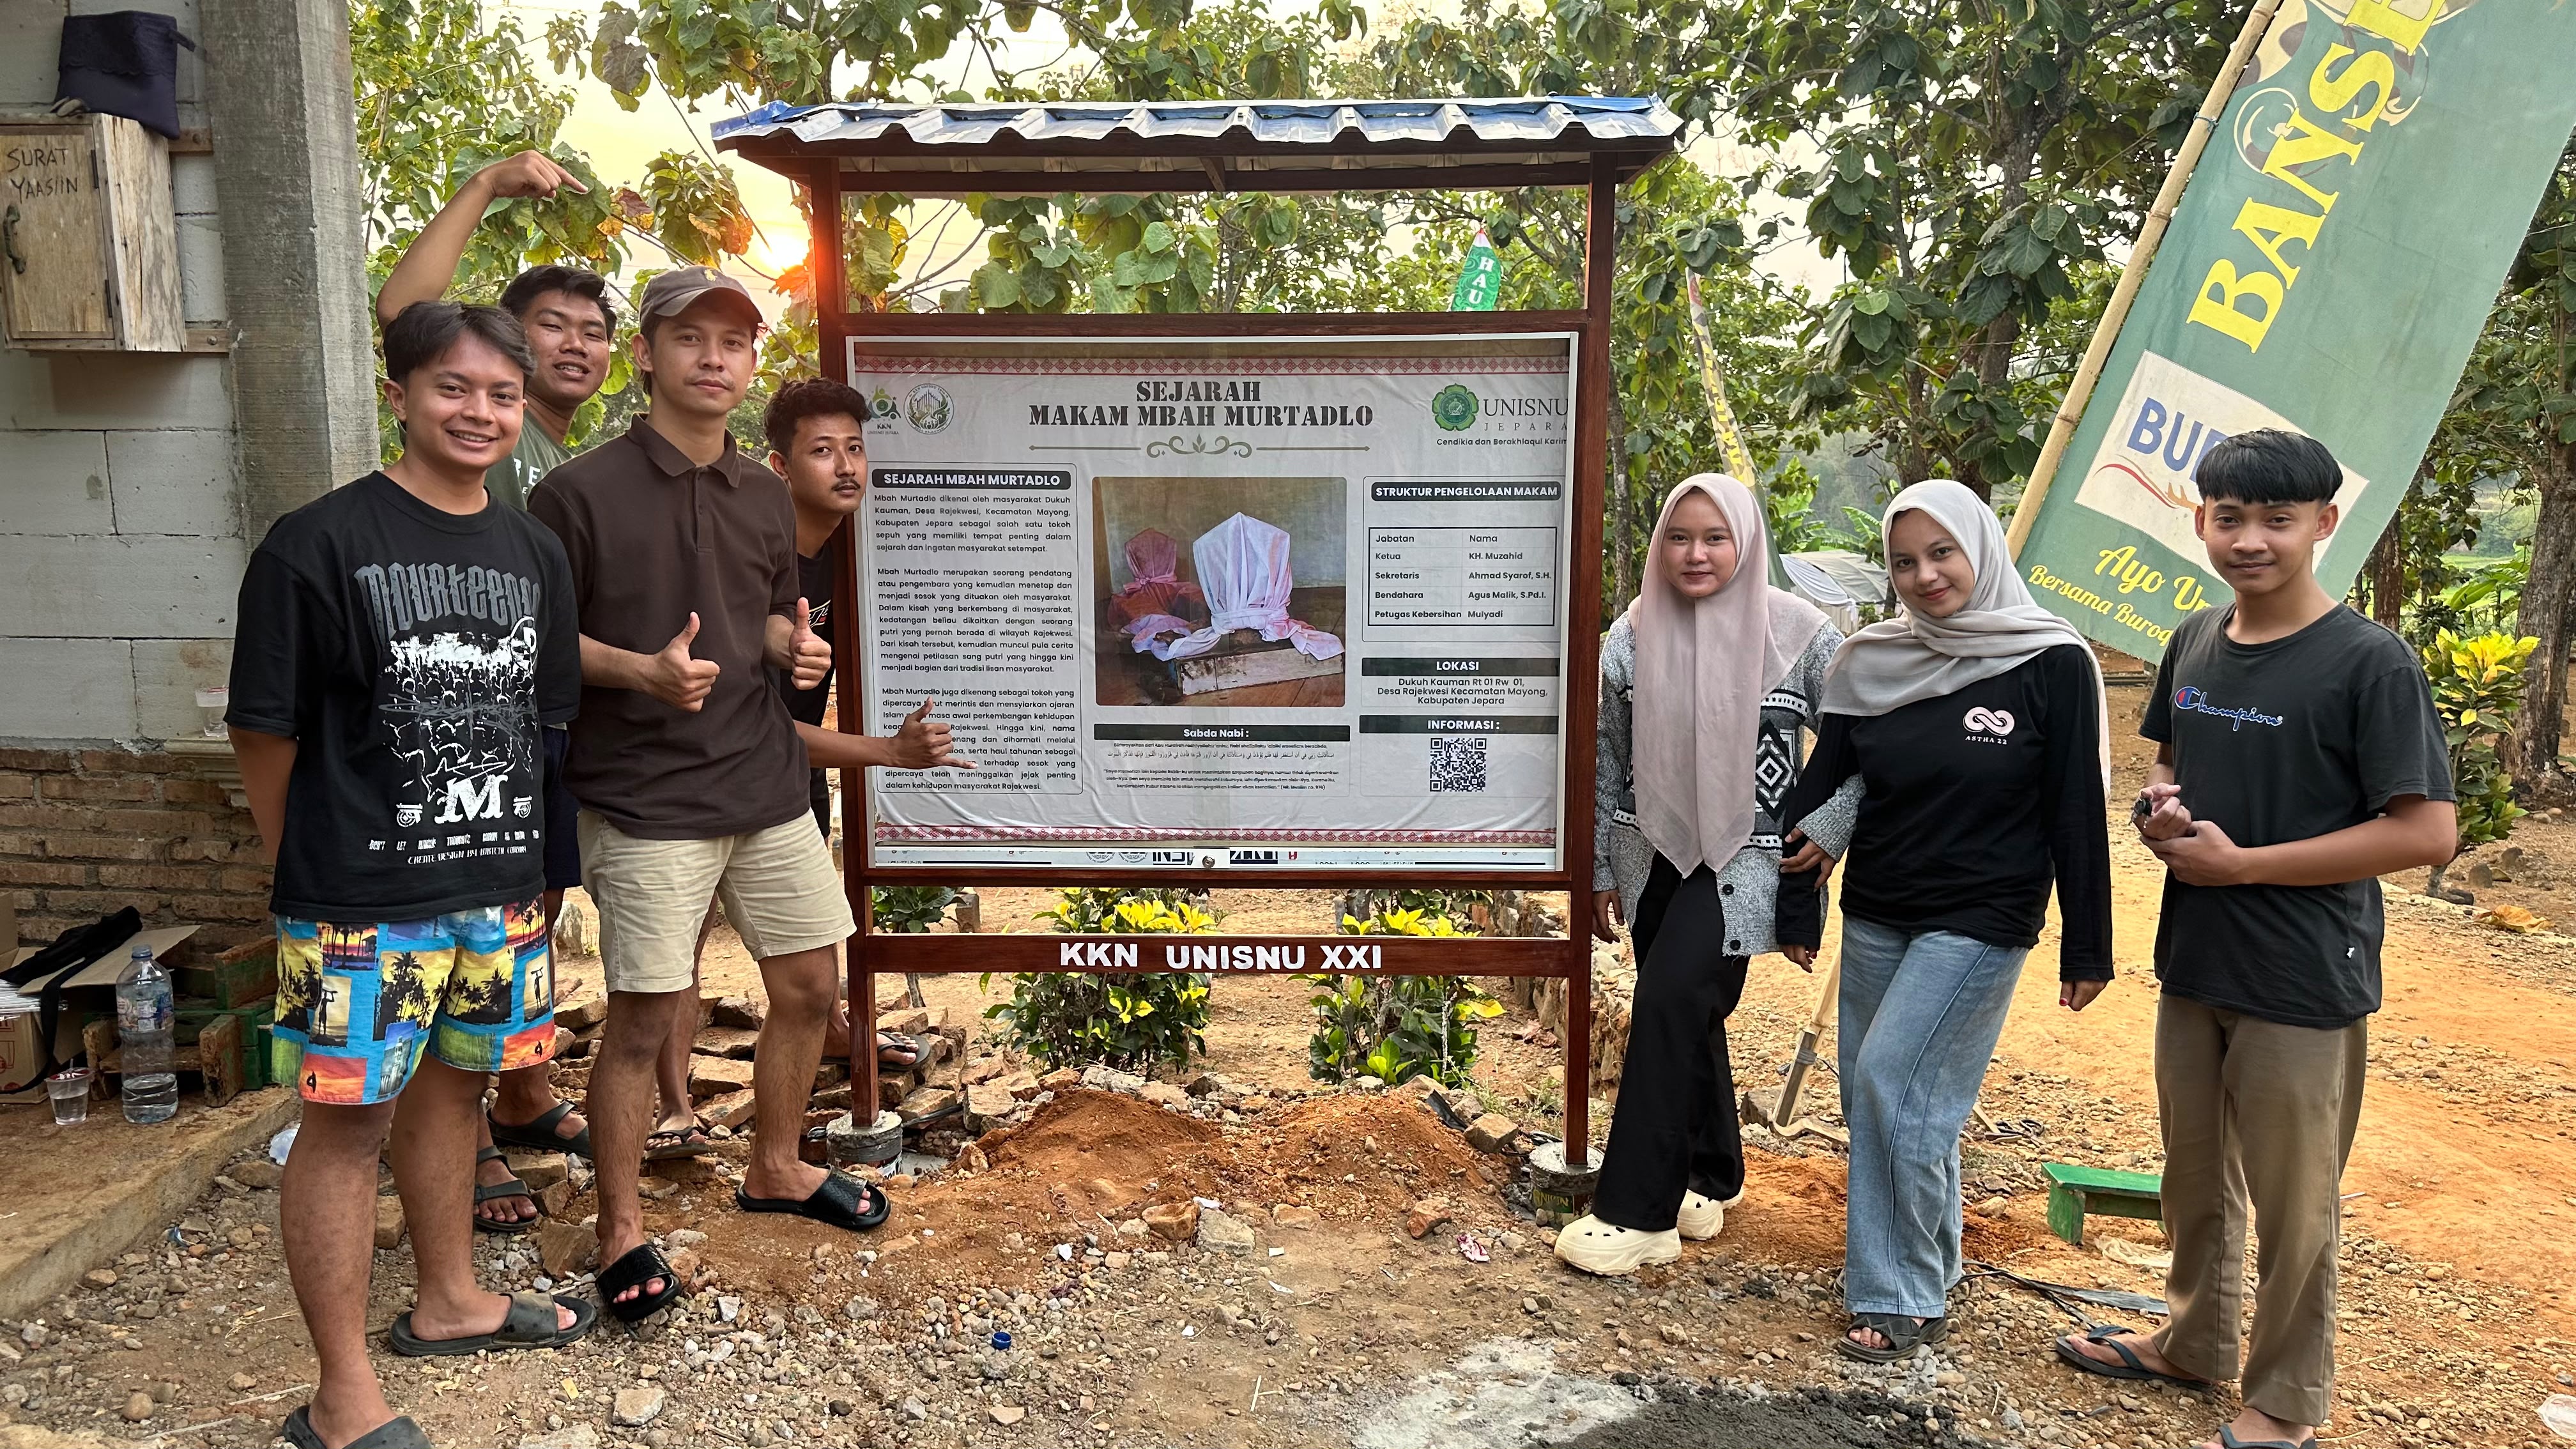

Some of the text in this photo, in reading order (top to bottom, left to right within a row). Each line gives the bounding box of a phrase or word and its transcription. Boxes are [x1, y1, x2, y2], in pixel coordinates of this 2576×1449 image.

[7, 148, 68, 172] SURAT
[10, 177, 78, 204] YAASIIN
[1466, 256, 1494, 310] HAU
[1137, 381, 1260, 401] SEJARAH
[1483, 399, 1568, 417] UNISNU
[1029, 405, 1372, 426] MAKAM MBAH MURTADLO
[1484, 422, 1567, 431] JEPARA
[1493, 438, 1542, 446] Berakhlaqul
[884, 473, 1059, 485] SEJARAH MBAH MURTADLO
[1376, 487, 1431, 496] STRUKTUR
[1514, 487, 1556, 495] MAKAM
[1037, 509, 1070, 517] Mayong,
[875, 519, 919, 528] Kabupaten
[959, 520, 990, 528] sebagai
[876, 532, 900, 540] sepuh
[1009, 533, 1038, 541] penting
[877, 544, 905, 552] sejarah
[925, 544, 955, 553] ingatan
[958, 544, 1006, 553] masyarakat
[943, 569, 988, 577] merupakan
[1029, 569, 1071, 578] pendatang
[2094, 546, 2166, 594] Ayo
[900, 581, 949, 589] pengembara
[2030, 565, 2113, 615] Bersama
[878, 592, 910, 601] menjadi
[1468, 592, 1490, 601] Agus
[1492, 591, 1518, 599] Malik,
[958, 605, 1007, 613] berkembang
[1023, 606, 1072, 614] masyarakat,
[1375, 611, 1410, 619] Petugas
[1468, 610, 1503, 620] Mulyadi
[882, 664, 912, 672] menjadi
[1437, 661, 1478, 670] LOKASI
[941, 688, 958, 696] juga
[961, 689, 996, 697] dikenang
[999, 689, 1029, 697] sebagai
[1403, 687, 1448, 696] Rajekwesi
[1508, 687, 1547, 696] Mayong,
[1418, 696, 1504, 705] Kabupaten Jepara
[2175, 686, 2283, 732] Champion
[1220, 728, 1243, 737] Nabi
[984, 759, 1019, 767] terhadap
[885, 770, 924, 778] dipercaya
[958, 770, 1013, 779] meninggalkan
[1021, 771, 1039, 779] jejak
[912, 781, 952, 790] kehidupan
[1002, 783, 1041, 791] Rajekwesi.
[1061, 943, 1381, 969] KKN UNISNU XXI
